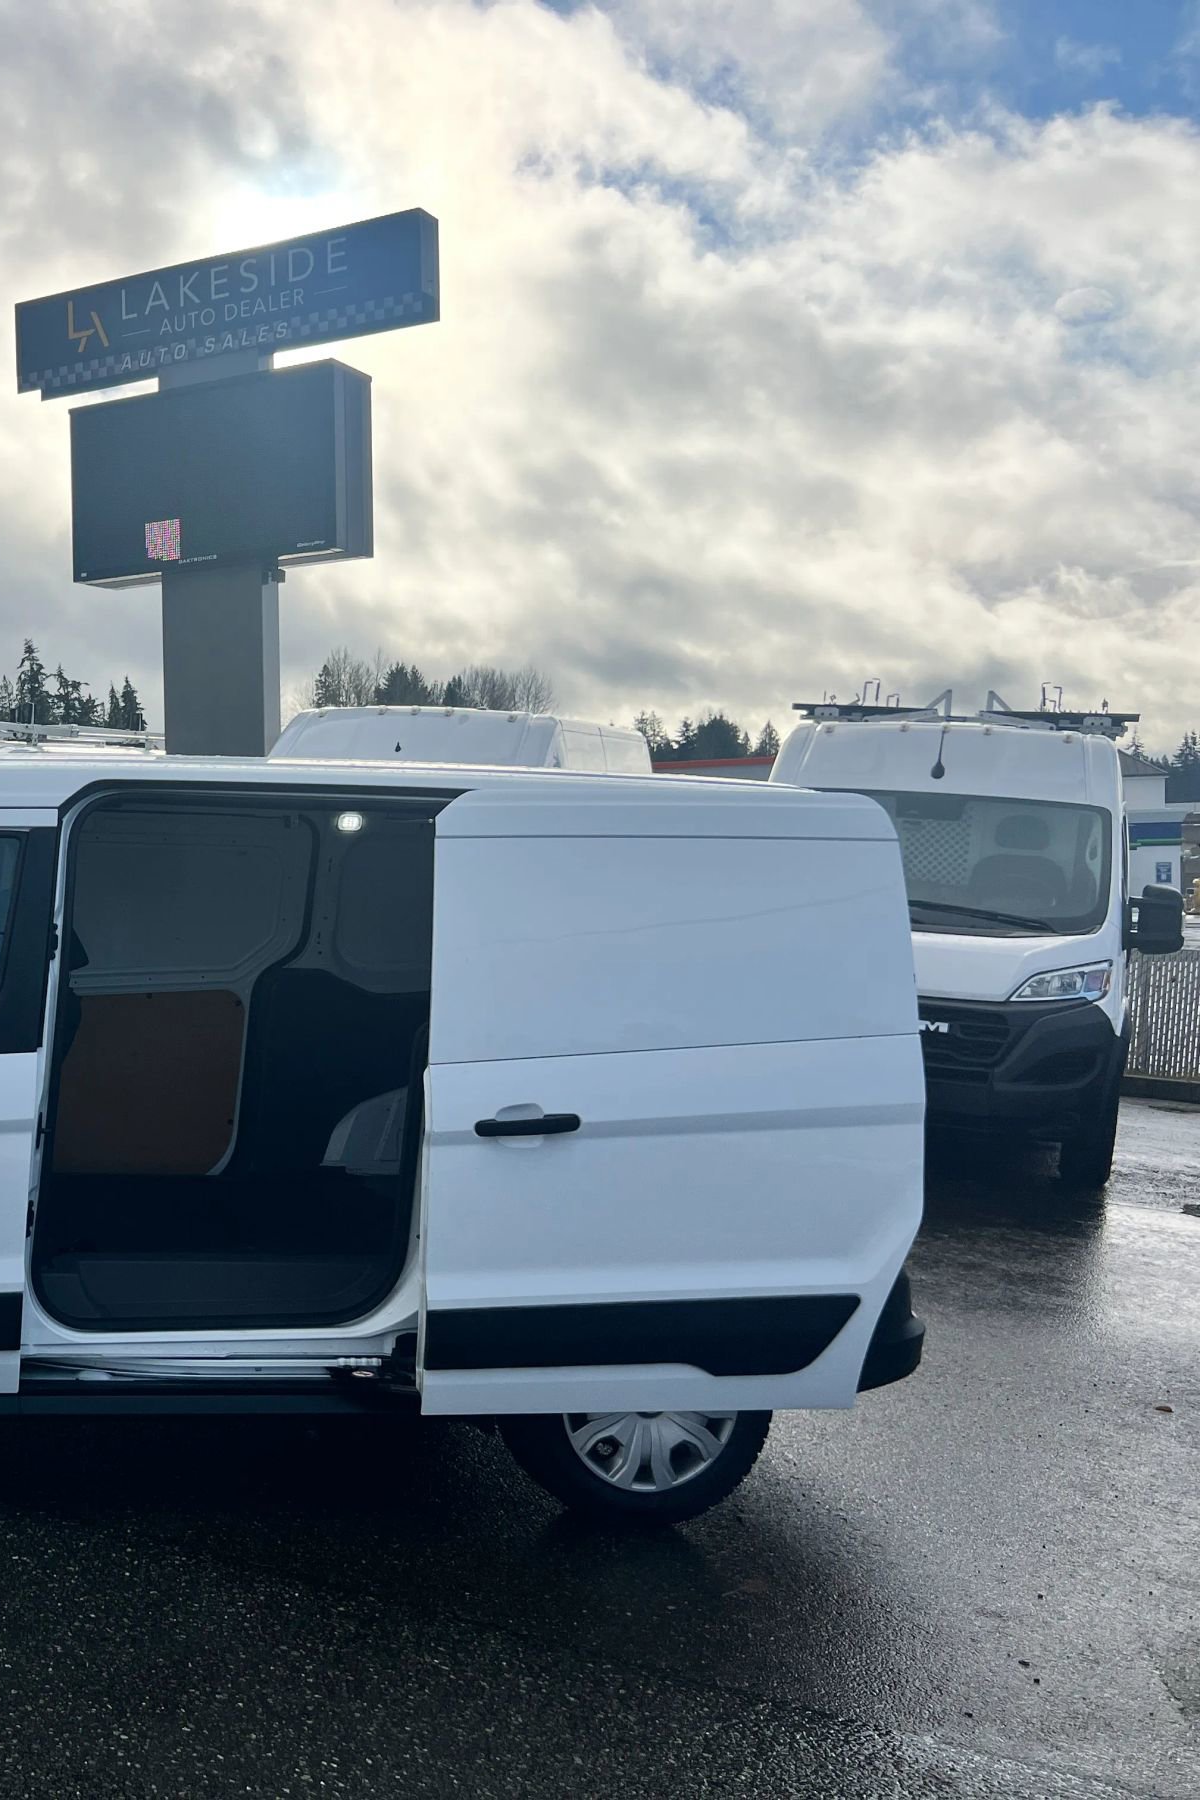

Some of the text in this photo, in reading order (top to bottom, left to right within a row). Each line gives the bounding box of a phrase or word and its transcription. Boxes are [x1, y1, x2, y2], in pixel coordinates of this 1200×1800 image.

[120, 237, 348, 320] LAKESIDE
[159, 287, 304, 335] AUTO DEALER
[120, 322, 288, 371] AUTO SALES
